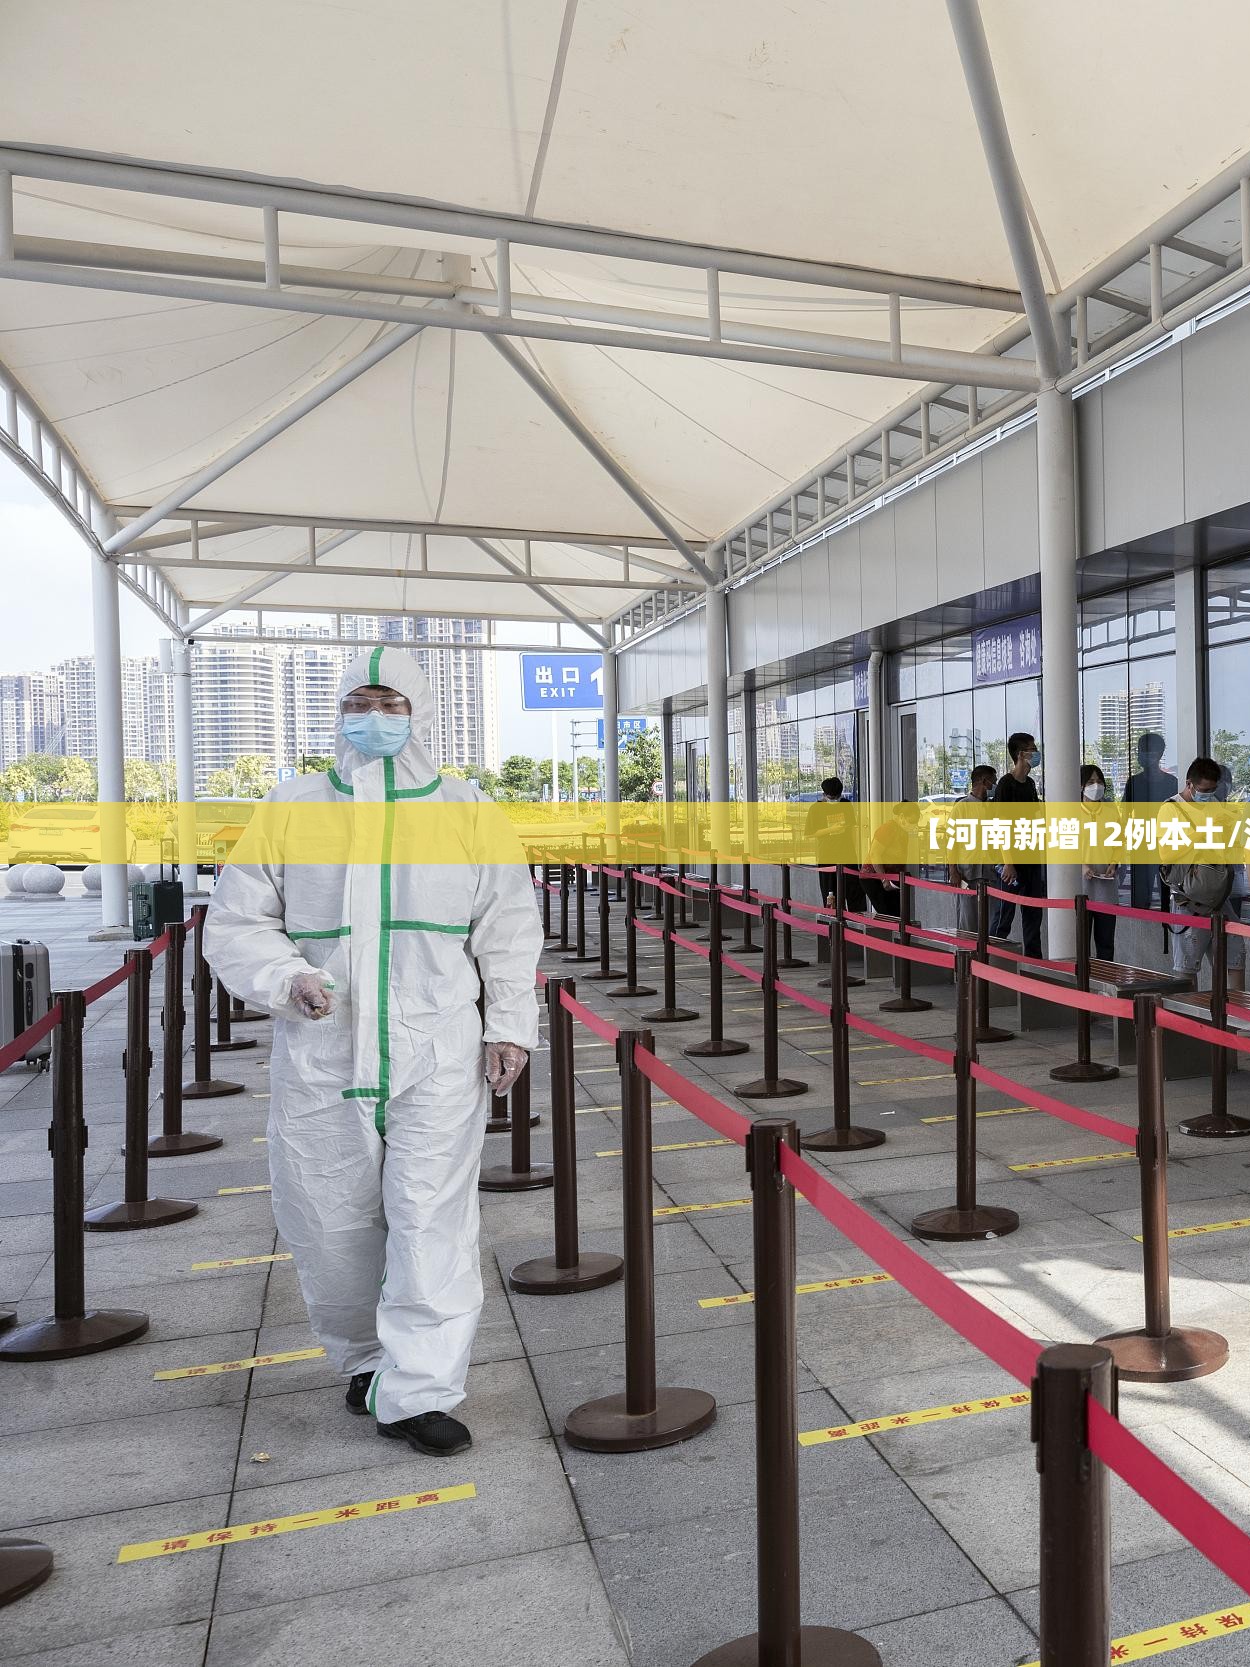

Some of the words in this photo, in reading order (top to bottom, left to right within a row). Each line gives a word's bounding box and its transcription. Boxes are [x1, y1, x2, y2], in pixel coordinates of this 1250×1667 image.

[535, 665, 580, 684] 出口
[540, 687, 576, 698] EXIT
[162, 1493, 440, 1552] 请保持一米距离
